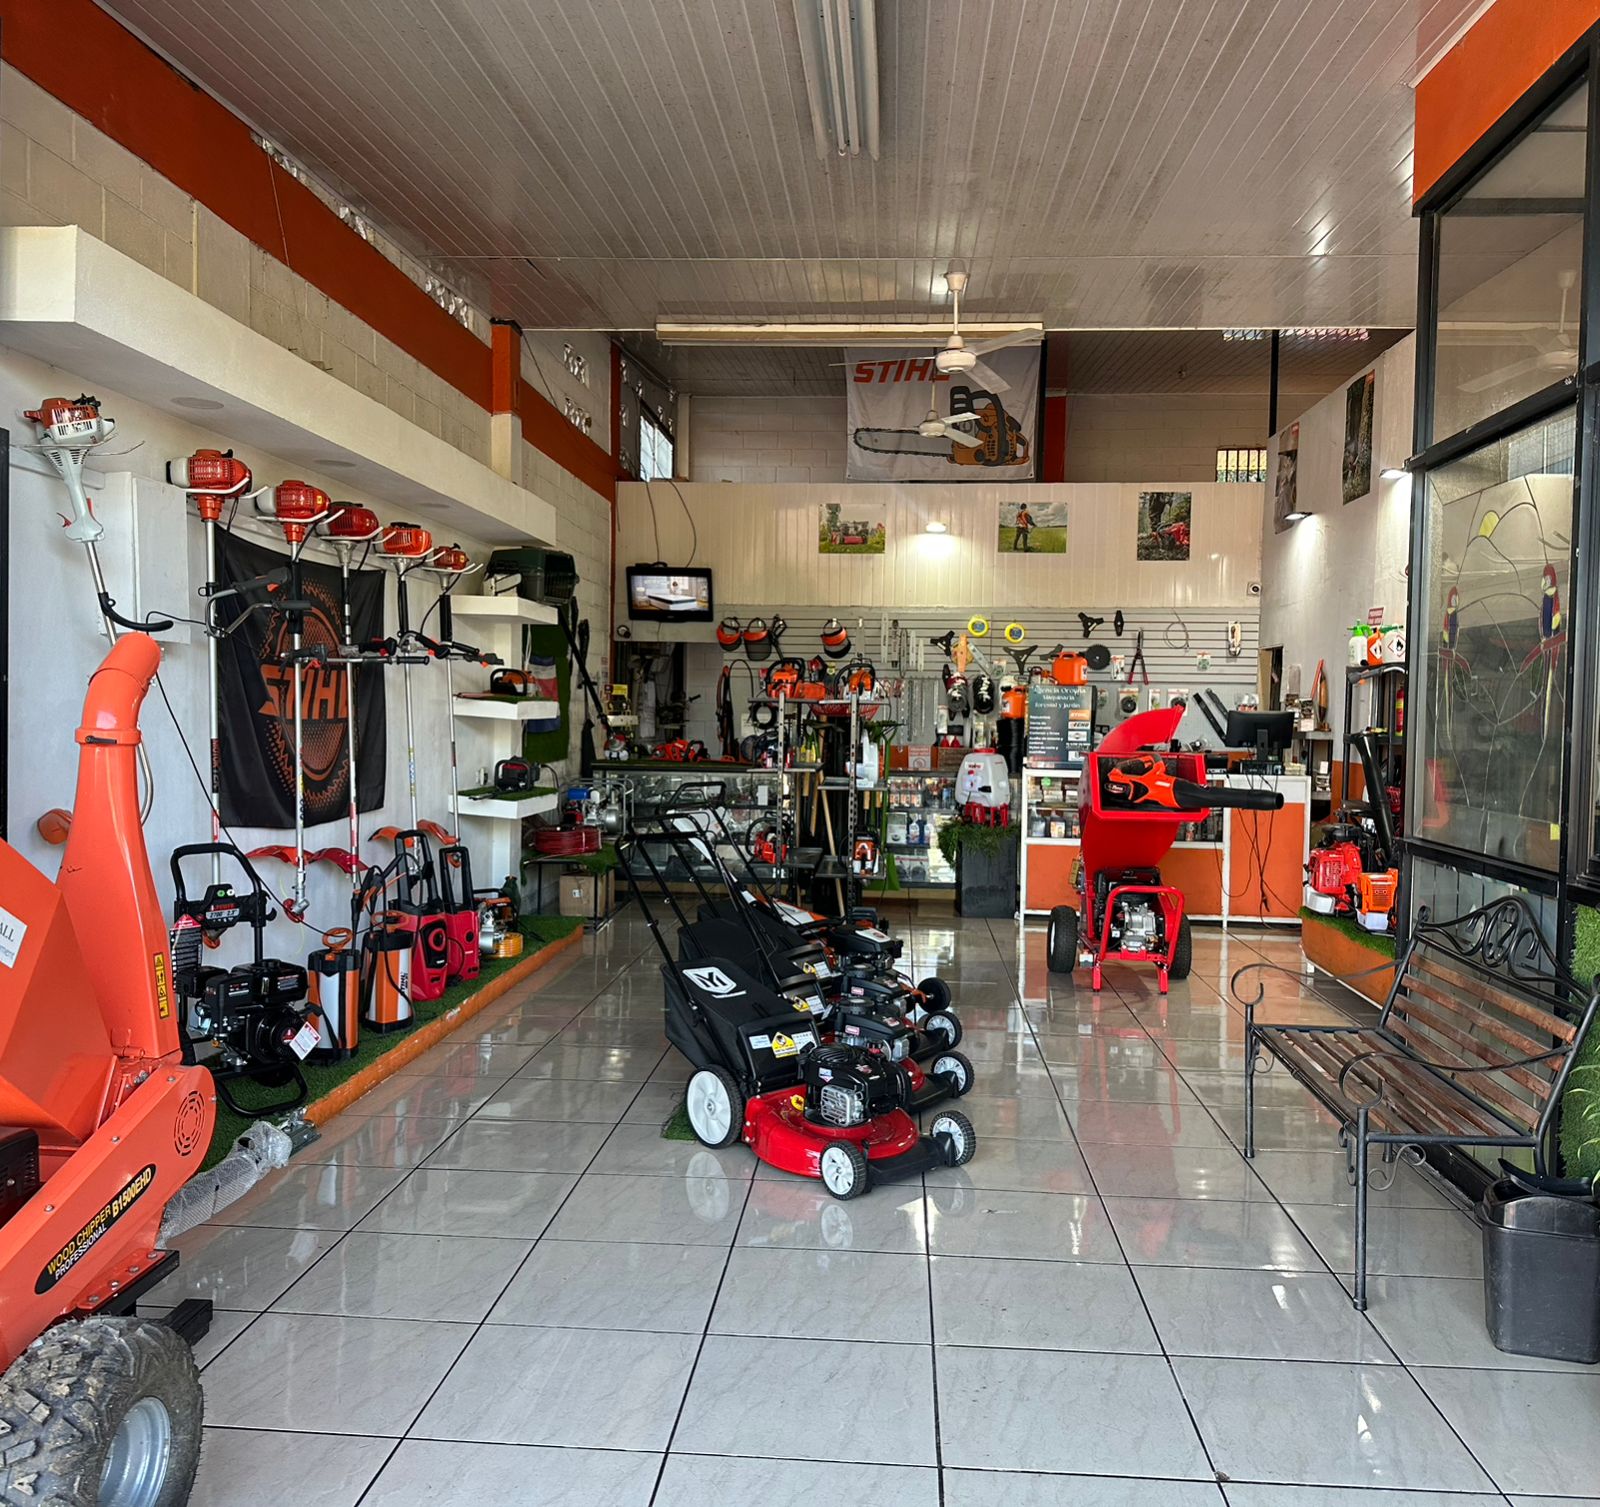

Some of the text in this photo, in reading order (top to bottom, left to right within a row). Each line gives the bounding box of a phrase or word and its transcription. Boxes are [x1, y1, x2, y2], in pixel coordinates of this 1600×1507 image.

[47, 1167, 152, 1275] WOOD CHIPPER B1500EHD
[55, 1223, 107, 1281] PROFESSIONAL
